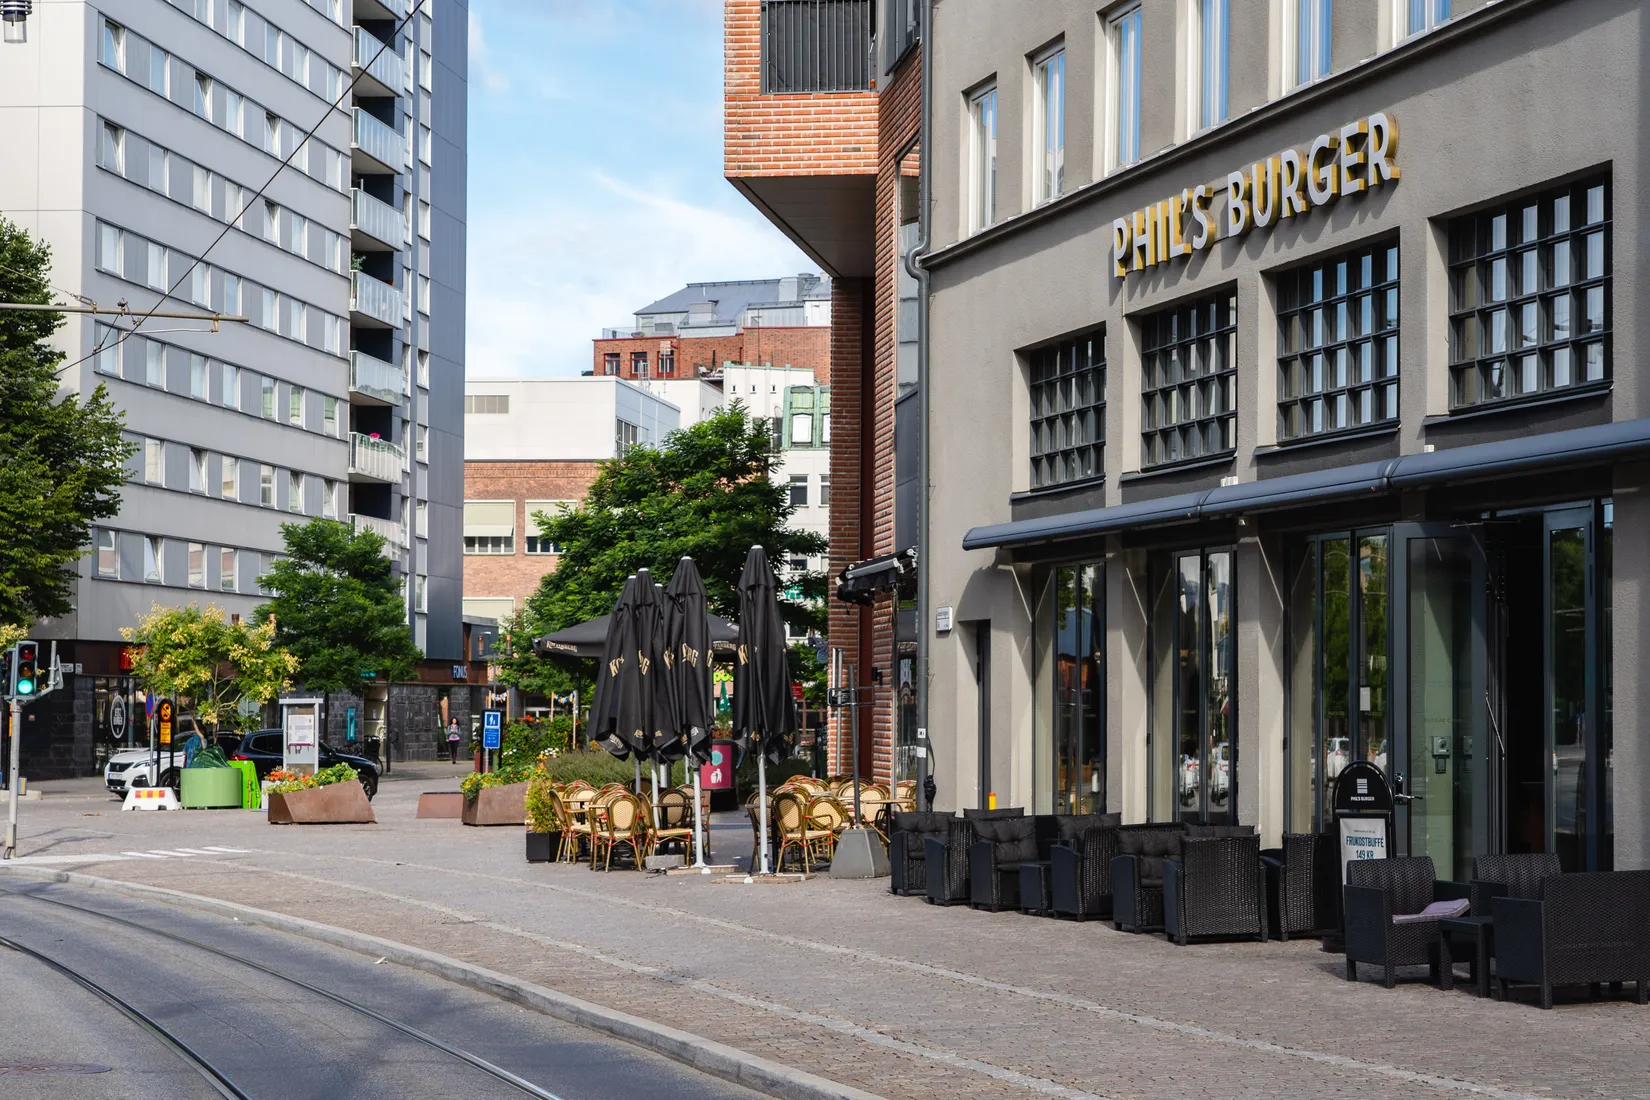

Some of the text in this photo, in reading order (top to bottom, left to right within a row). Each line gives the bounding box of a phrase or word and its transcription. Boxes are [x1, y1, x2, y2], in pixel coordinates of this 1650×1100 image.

[1113, 112, 1400, 278] PHIL'S BURGER
[453, 665, 467, 678] FONUS
[1346, 834, 1384, 848] FRUKOSTBUFFÉ
[1356, 849, 1366, 859] 149
